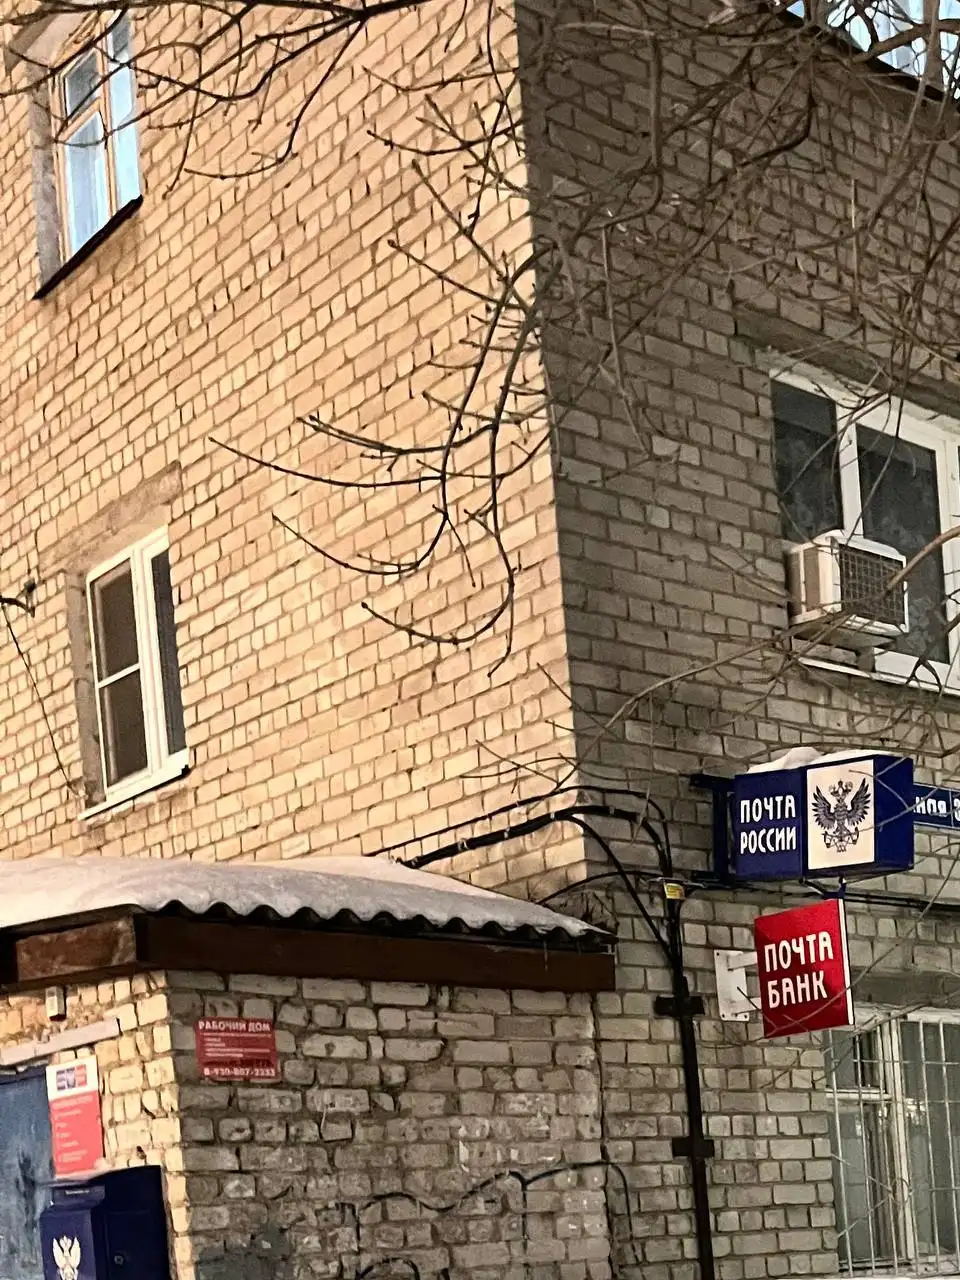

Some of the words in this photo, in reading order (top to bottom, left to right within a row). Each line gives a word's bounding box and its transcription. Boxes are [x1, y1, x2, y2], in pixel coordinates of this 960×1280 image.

[740, 794, 796, 824] ПОЧТА
[740, 826, 797, 855] РОССИИ
[764, 931, 834, 973] ПОЧТА
[767, 970, 828, 1009] БАНК
[248, 1021, 271, 1033] ДОМ
